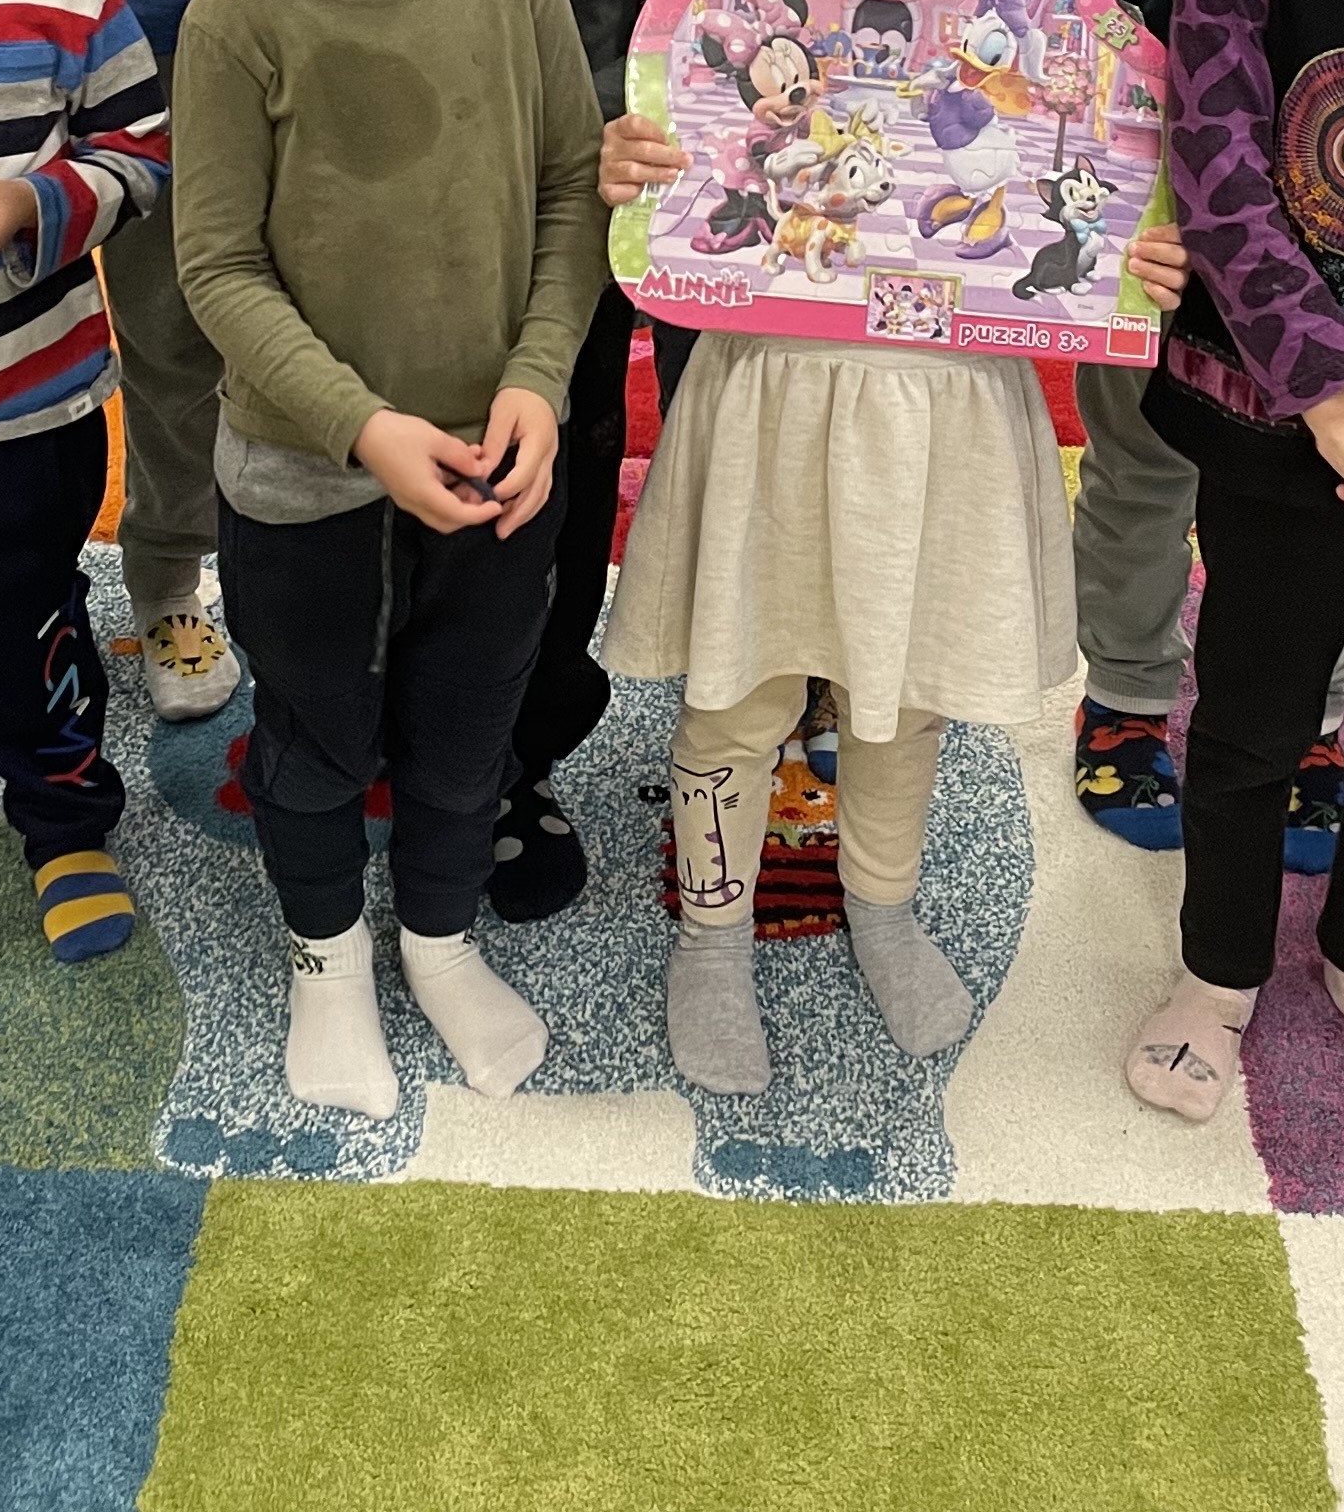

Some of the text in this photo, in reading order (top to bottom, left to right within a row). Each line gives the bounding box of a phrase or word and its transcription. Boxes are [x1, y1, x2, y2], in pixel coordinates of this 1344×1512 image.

[1106, 18, 1127, 37] 25
[635, 264, 754, 307] MINNIE
[1112, 316, 1148, 333] Dino
[958, 322, 1089, 353] puzzle 3+
